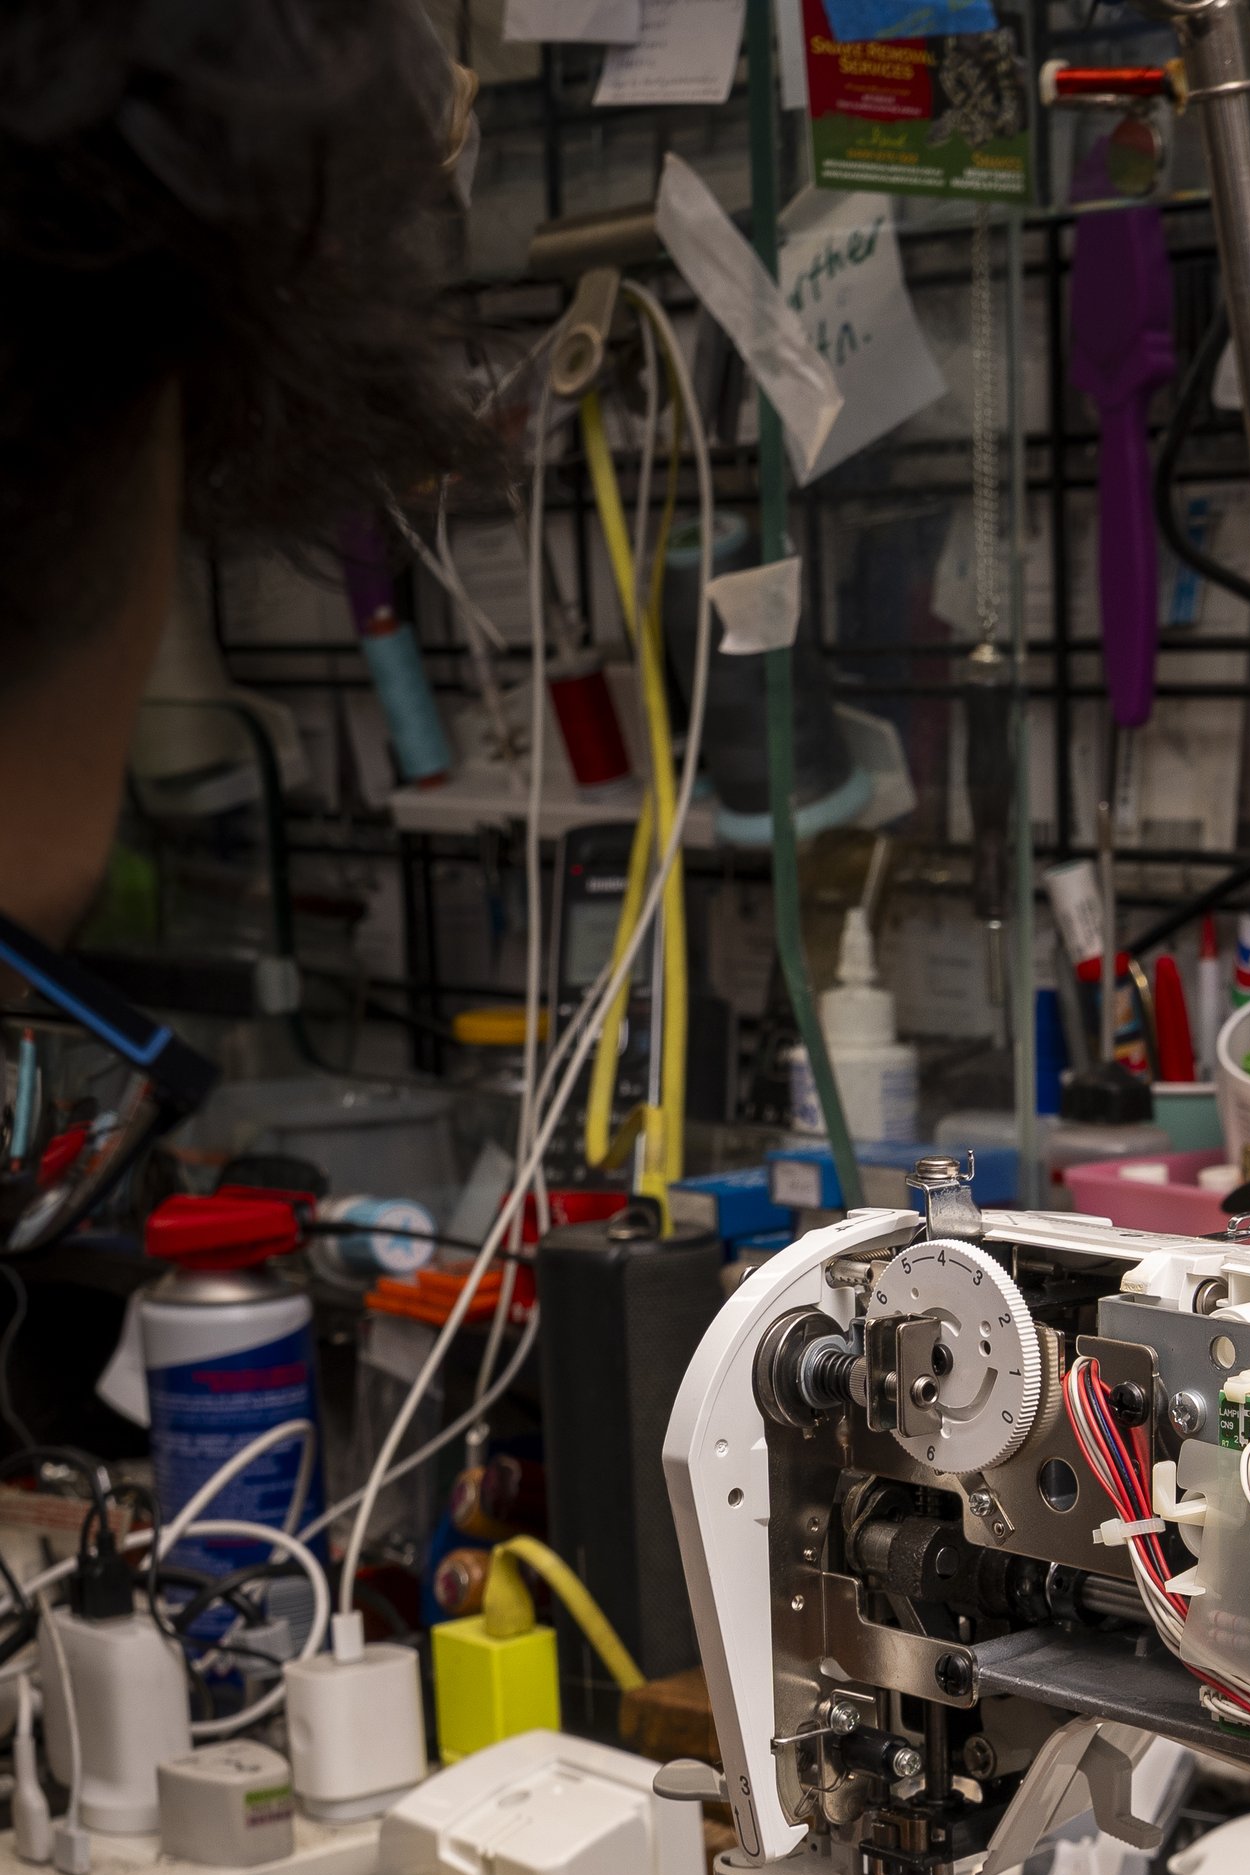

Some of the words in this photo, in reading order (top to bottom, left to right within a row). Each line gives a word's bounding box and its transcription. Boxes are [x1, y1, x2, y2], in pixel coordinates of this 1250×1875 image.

[901, 1257, 912, 1275] 5
[936, 1249, 946, 1267] 4
[972, 1270, 984, 1286] 3
[876, 1290, 888, 1305] 6
[998, 1313, 1011, 1328] 2
[1009, 1368, 1022, 1377] 1
[1001, 1410, 1013, 1424] 0
[1220, 1420, 1234, 1430] CN9
[1233, 1435, 1239, 1444] 2
[740, 1775, 751, 1796] 3
